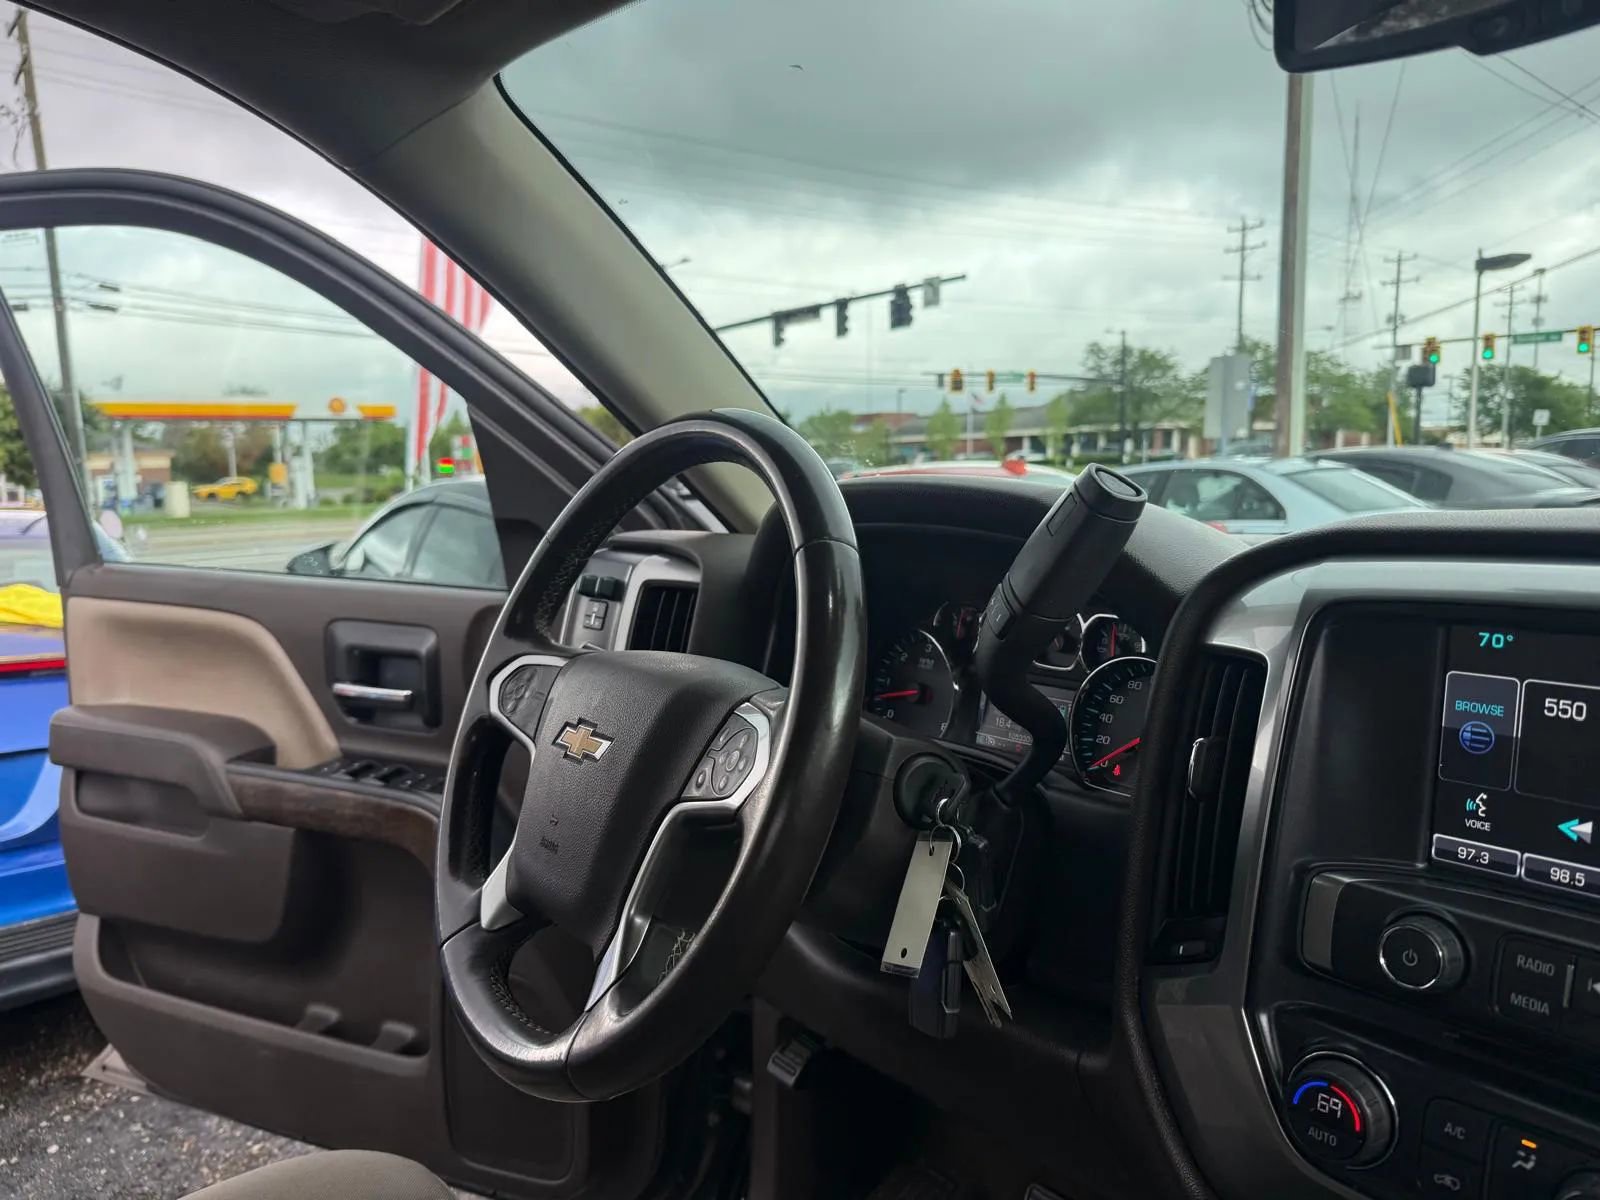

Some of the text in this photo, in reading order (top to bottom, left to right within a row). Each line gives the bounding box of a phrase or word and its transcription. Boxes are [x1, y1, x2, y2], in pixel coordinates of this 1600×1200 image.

[1127, 681, 1143, 690] 80
[1109, 694, 1124, 705] 60
[1455, 700, 1504, 717] BROWSE
[1099, 712, 1114, 724] 40
[1544, 698, 1587, 721] 550
[1096, 735, 1111, 745] 20
[1464, 818, 1491, 832] VOICE
[1457, 846, 1489, 864] 97.3
[1550, 867, 1585, 887] 98.5
[1516, 954, 1555, 977] RADIO
[1510, 992, 1550, 1016] MEDIA
[1316, 1093, 1342, 1119] 69
[1307, 1125, 1337, 1147] AUTO
[1443, 1121, 1466, 1140] A/C
